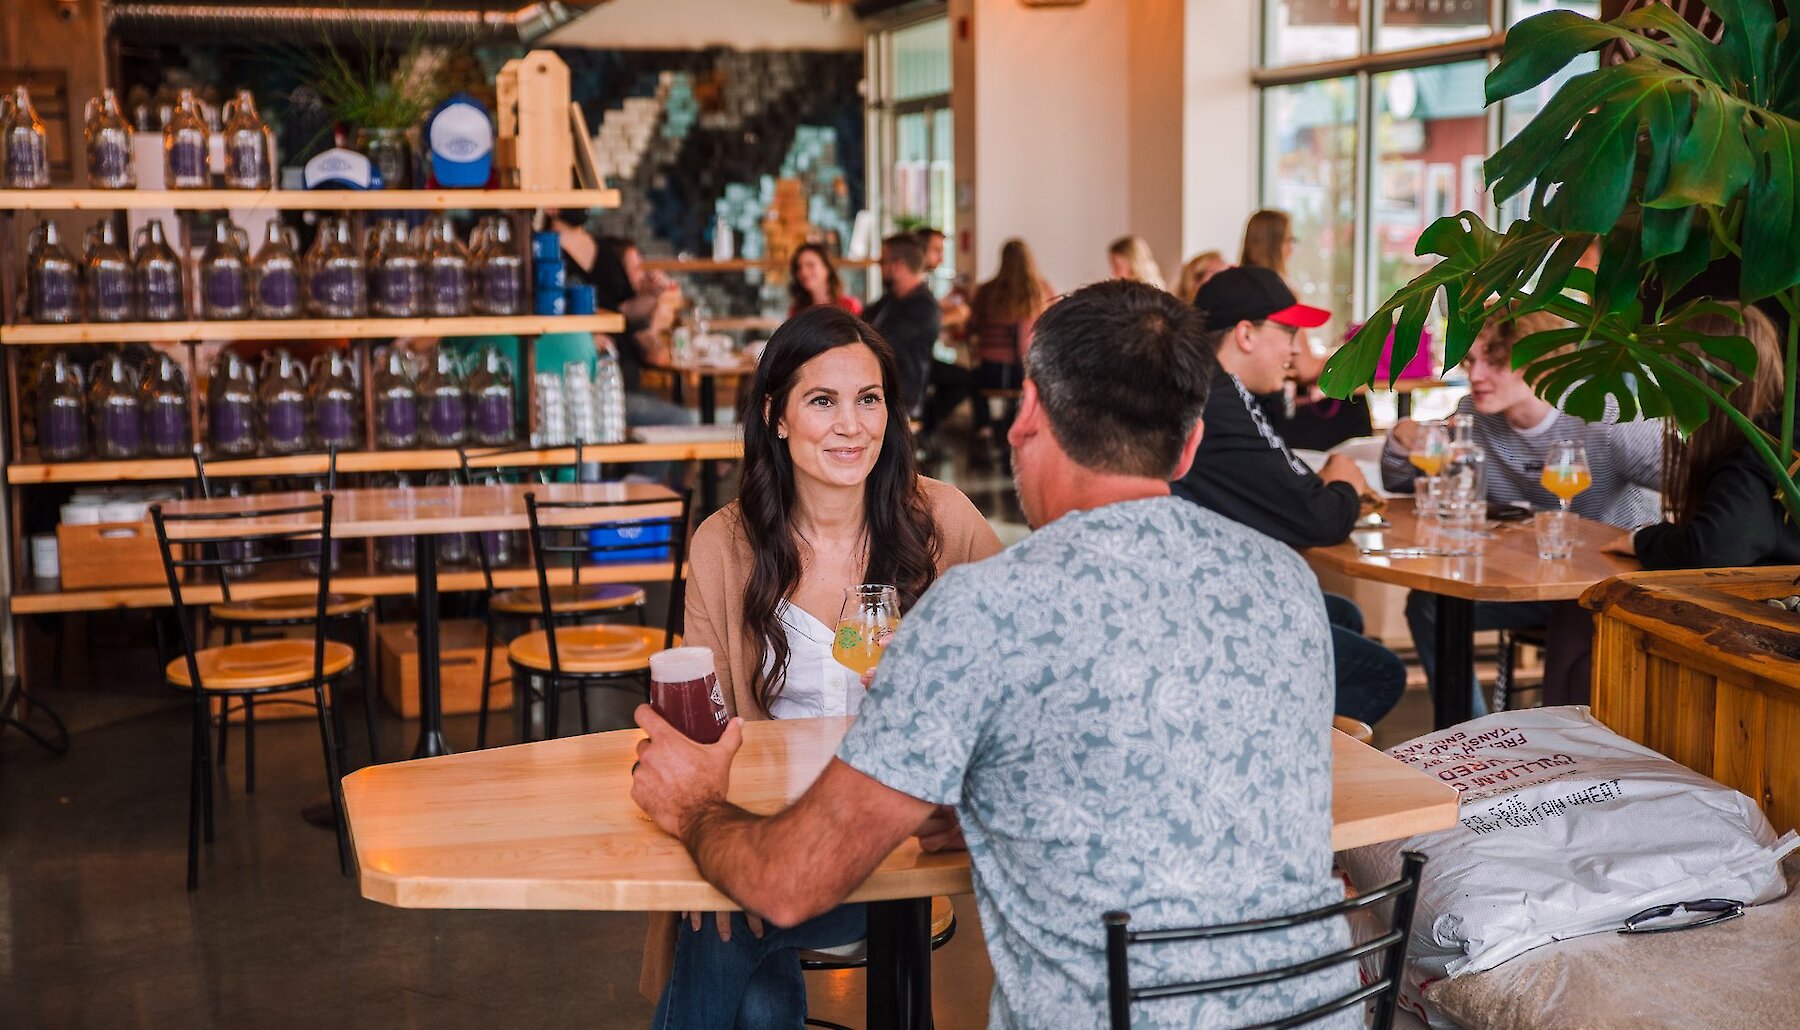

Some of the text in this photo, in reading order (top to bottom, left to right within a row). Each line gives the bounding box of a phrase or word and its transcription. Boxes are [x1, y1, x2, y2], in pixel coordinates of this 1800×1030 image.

[1461, 733, 1528, 755] FREH
[1504, 798, 1567, 828] CONTAIN
[1565, 778, 1622, 806] WHEAT
